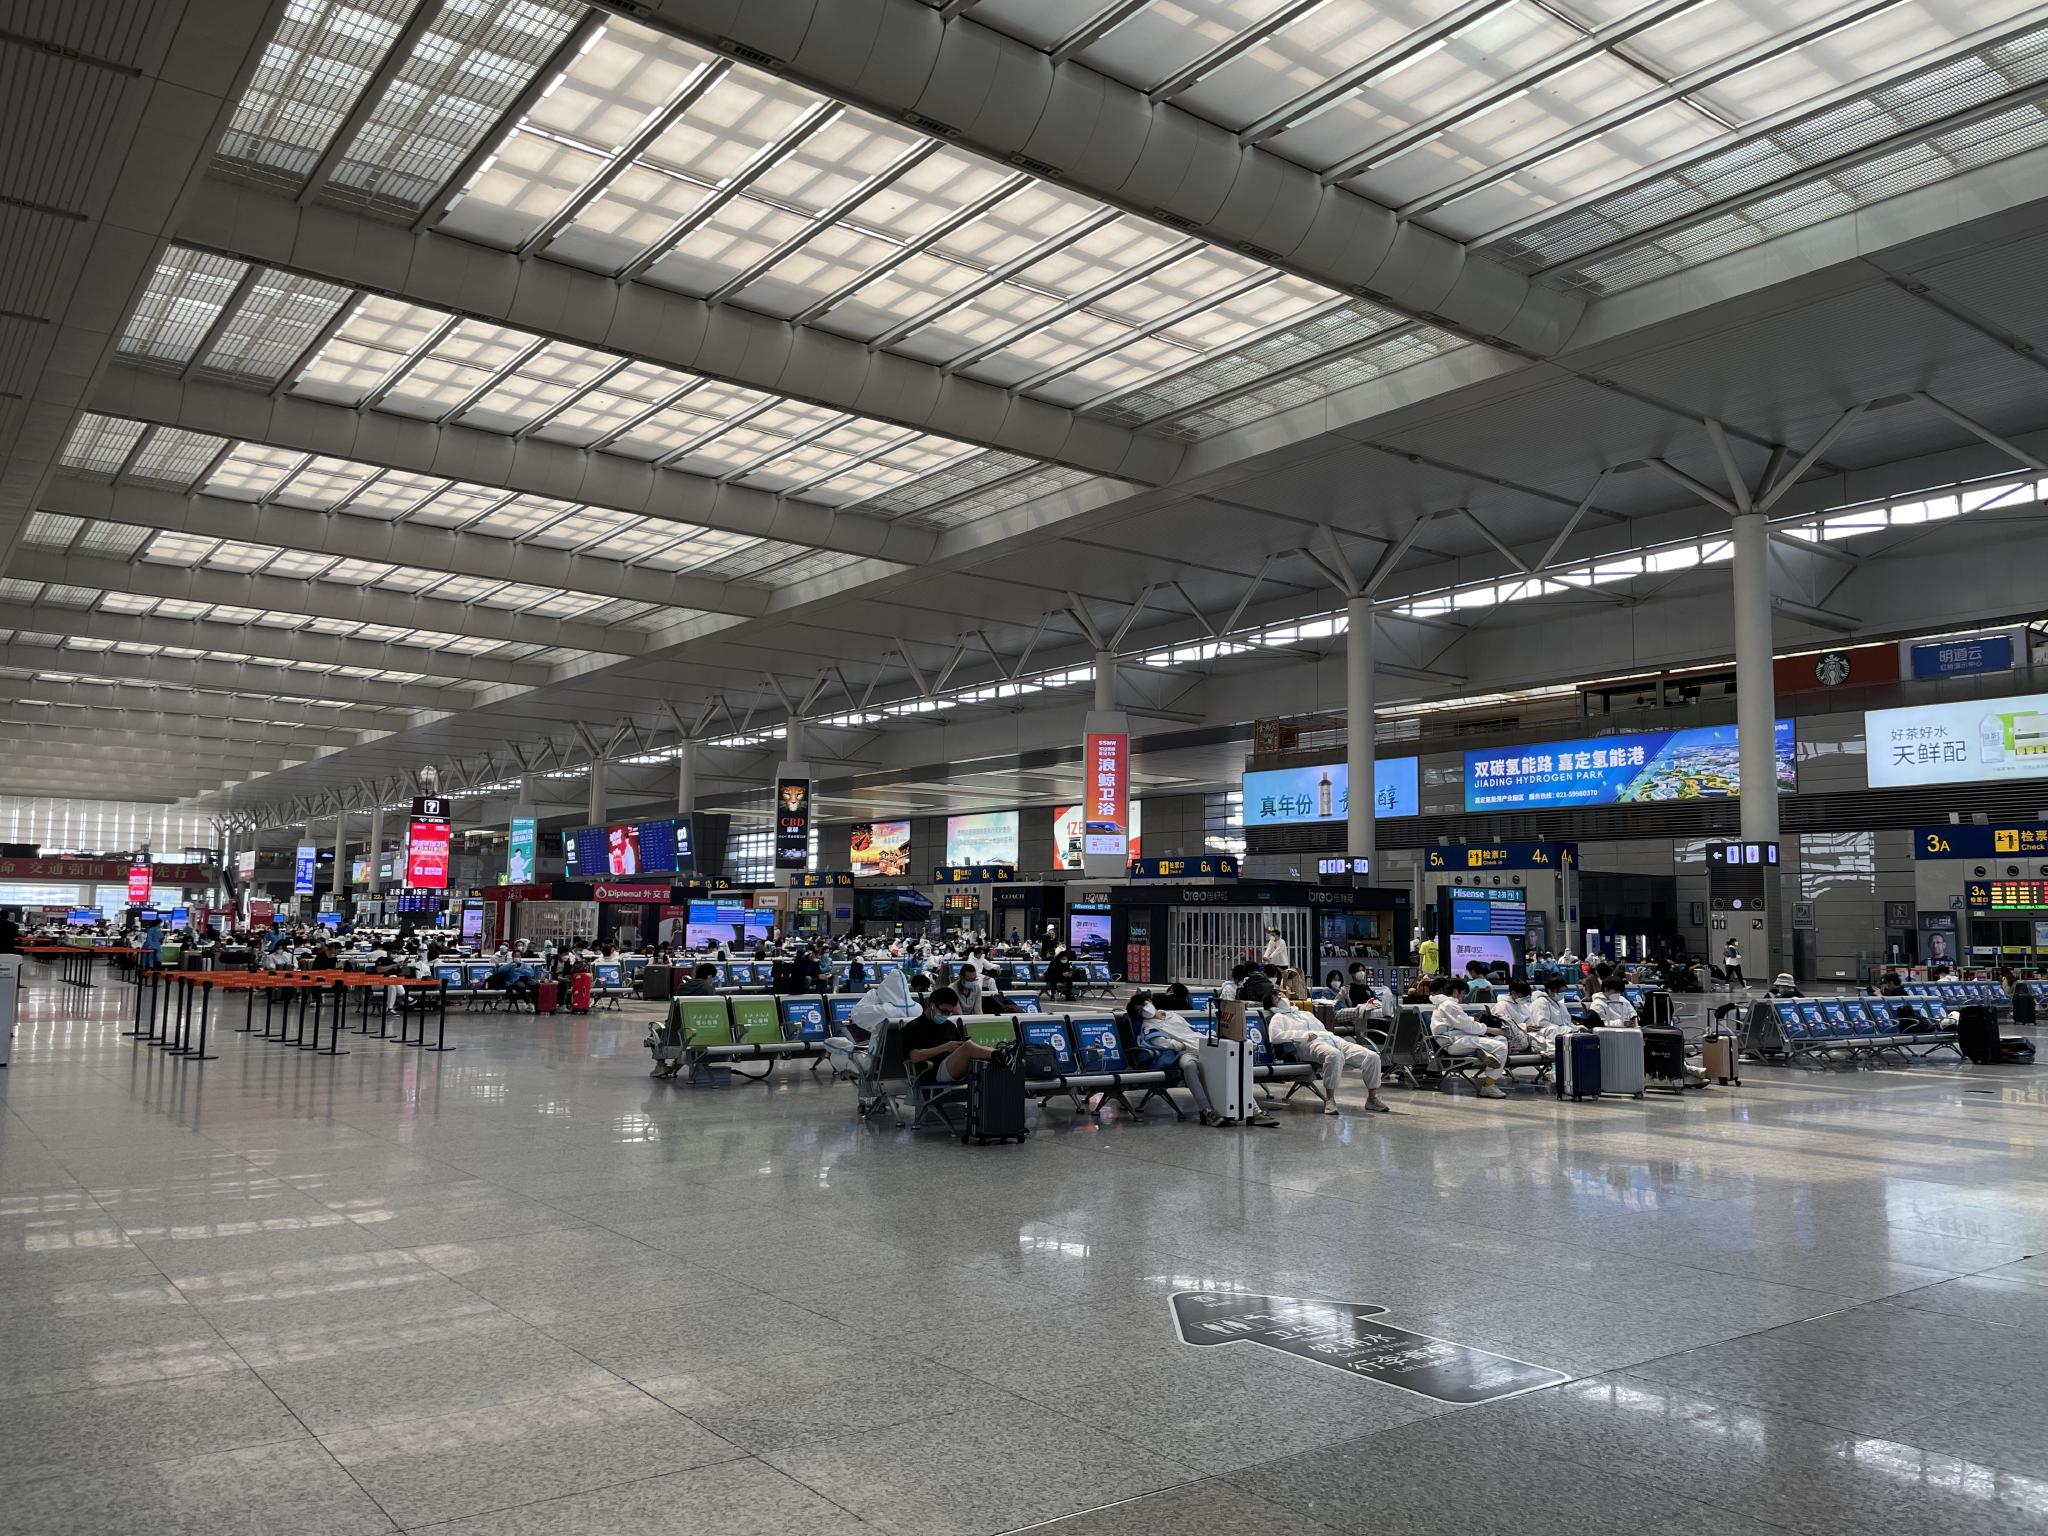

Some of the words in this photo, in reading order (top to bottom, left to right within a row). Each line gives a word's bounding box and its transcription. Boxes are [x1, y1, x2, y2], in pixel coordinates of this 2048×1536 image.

[1939, 647, 1983, 663] 明道云
[1890, 725, 1948, 742] 好茶好水
[1893, 741, 1967, 766] 天鲜配
[1474, 755, 1552, 777] 双碳氢能路
[1558, 746, 1645, 772] 嘉定氢能港
[1474, 777, 1513, 788] JIADING
[1516, 772, 1573, 785] HYDROGEN
[1576, 769, 1604, 780] PARK
[1097, 758, 1116, 816] 浪鲸卫浴
[1260, 793, 1313, 817] 真年份
[780, 817, 805, 827] CBD
[2020, 829, 2048, 842] 检票
[1926, 834, 1951, 853] 3A
[2021, 843, 2046, 851] Check
[1430, 852, 1445, 866] 5A
[1483, 849, 1507, 860] 检票口
[1532, 848, 1549, 864] 4A
[1560, 848, 1573, 864] 4A
[30, 862, 104, 876] 交通强国
[1134, 862, 1145, 875] 7A
[1200, 860, 1211, 873] 6A
[1220, 860, 1232, 873] 6A
[837, 874, 851, 886] 10A
[997, 869, 1008, 880] 8A
[715, 879, 729, 889] 12A
[1971, 885, 1986, 896] 3A
[607, 889, 641, 899] Diplomat
[643, 890, 671, 899] 外交官
[1183, 889, 1207, 902] breo
[1308, 889, 1332, 902] breo
[1453, 888, 1485, 899] Hisense
[1264, 1320, 1354, 1342] 卫生间
[1308, 1333, 1397, 1354] 饮用水
[1347, 1343, 1456, 1372] 行李寄存
